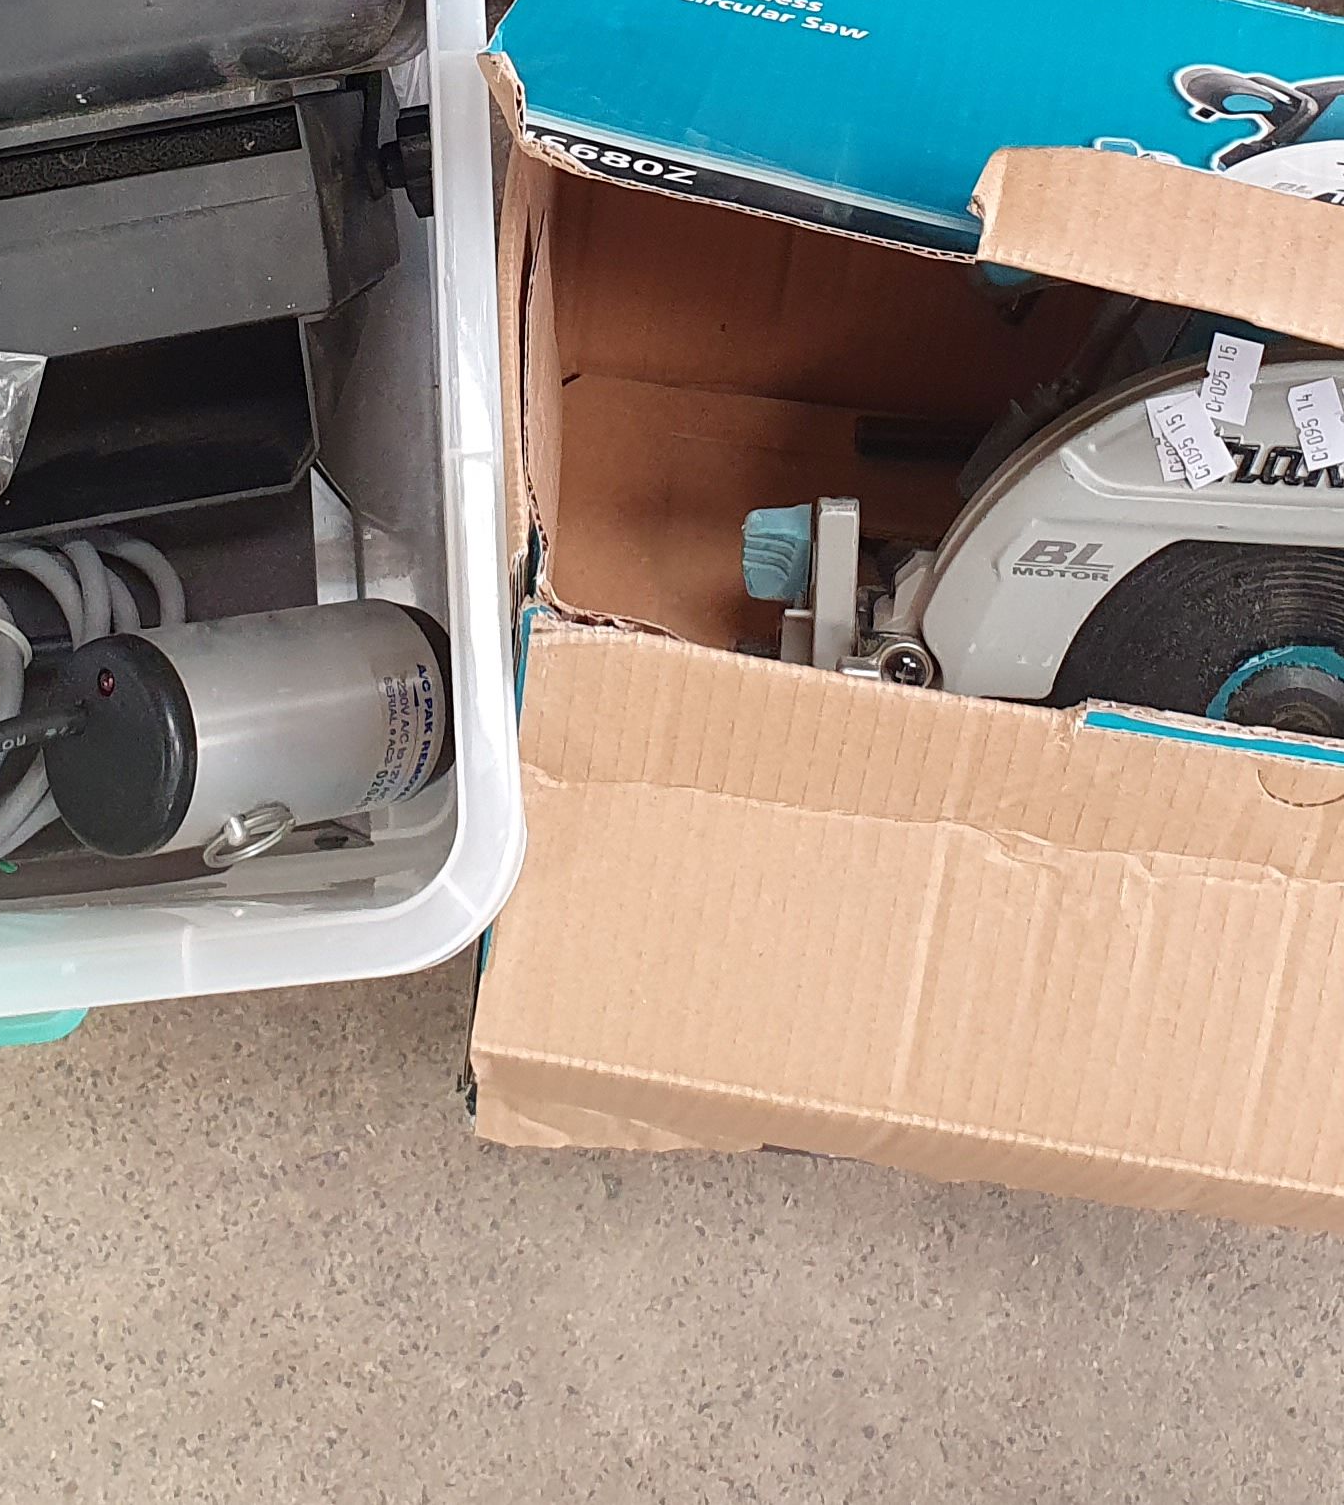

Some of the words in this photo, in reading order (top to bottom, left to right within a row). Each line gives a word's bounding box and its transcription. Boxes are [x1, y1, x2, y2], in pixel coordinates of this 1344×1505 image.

[800, 15, 868, 41] Saw
[1217, 343, 1238, 362] 15
[1164, 412, 1184, 434] 15
[1017, 537, 1115, 568] BL
[1011, 566, 1109, 582] MOTOR
[415, 664, 432, 692] A/C
[382, 675, 396, 725] SERIAL
[396, 679, 411, 715] 230V
[423, 697, 433, 733] PAK
